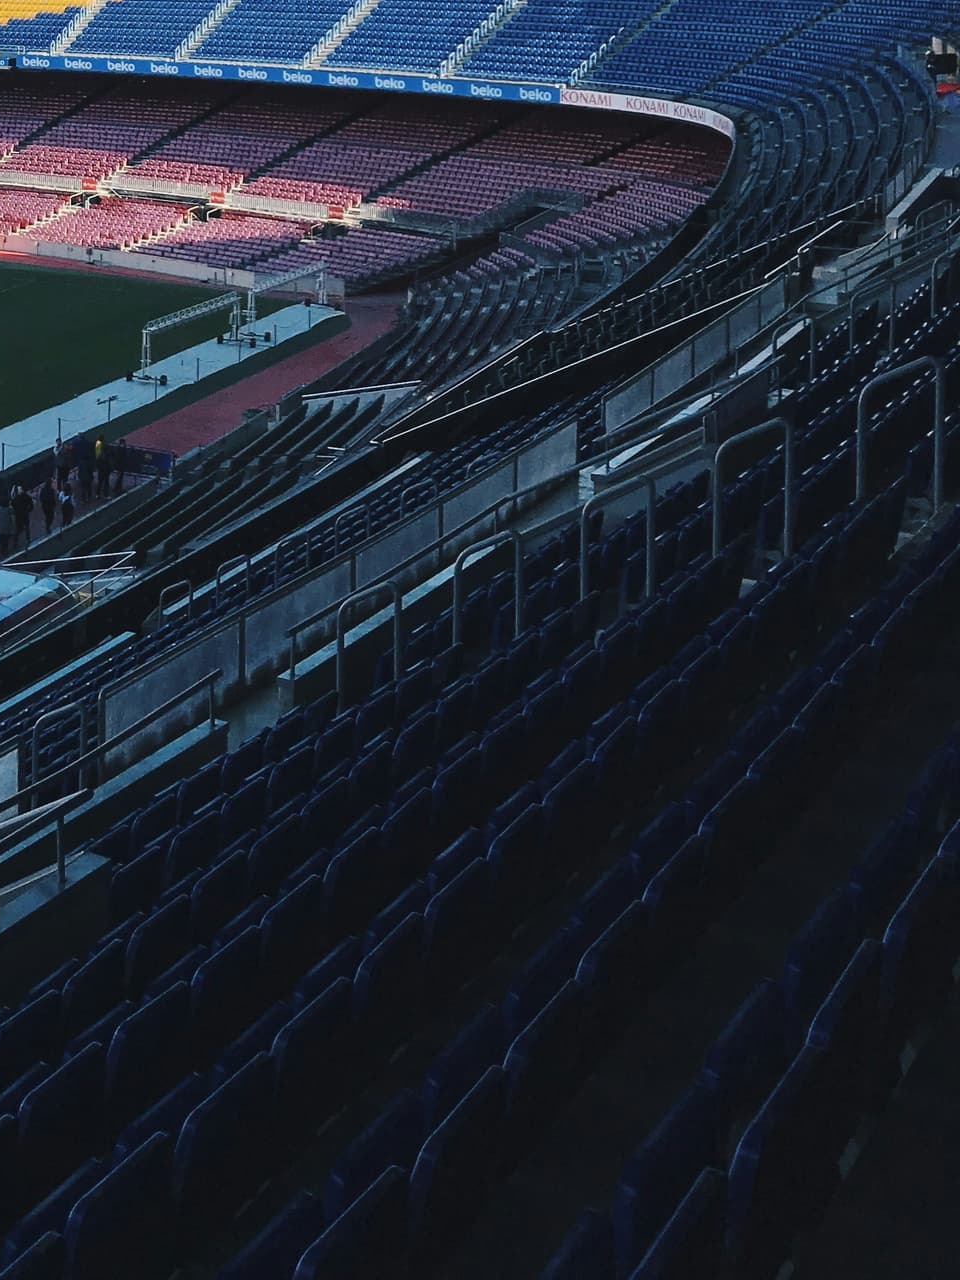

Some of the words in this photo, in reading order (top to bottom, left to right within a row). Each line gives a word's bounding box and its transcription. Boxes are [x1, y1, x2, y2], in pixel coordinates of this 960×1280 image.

[23, 55, 50, 67] beko
[64, 58, 92, 69] beko
[107, 61, 135, 72] beko
[150, 63, 179, 74] beko
[194, 65, 223, 77] beko
[238, 68, 267, 80] beko
[283, 70, 312, 83] beko
[329, 73, 359, 87] beko
[375, 76, 405, 89] beko
[422, 80, 454, 94] beko
[471, 84, 502, 98] beko
[519, 87, 552, 102] beko
[560, 89, 612, 107] KONAMI
[625, 97, 668, 113] KONAMI
